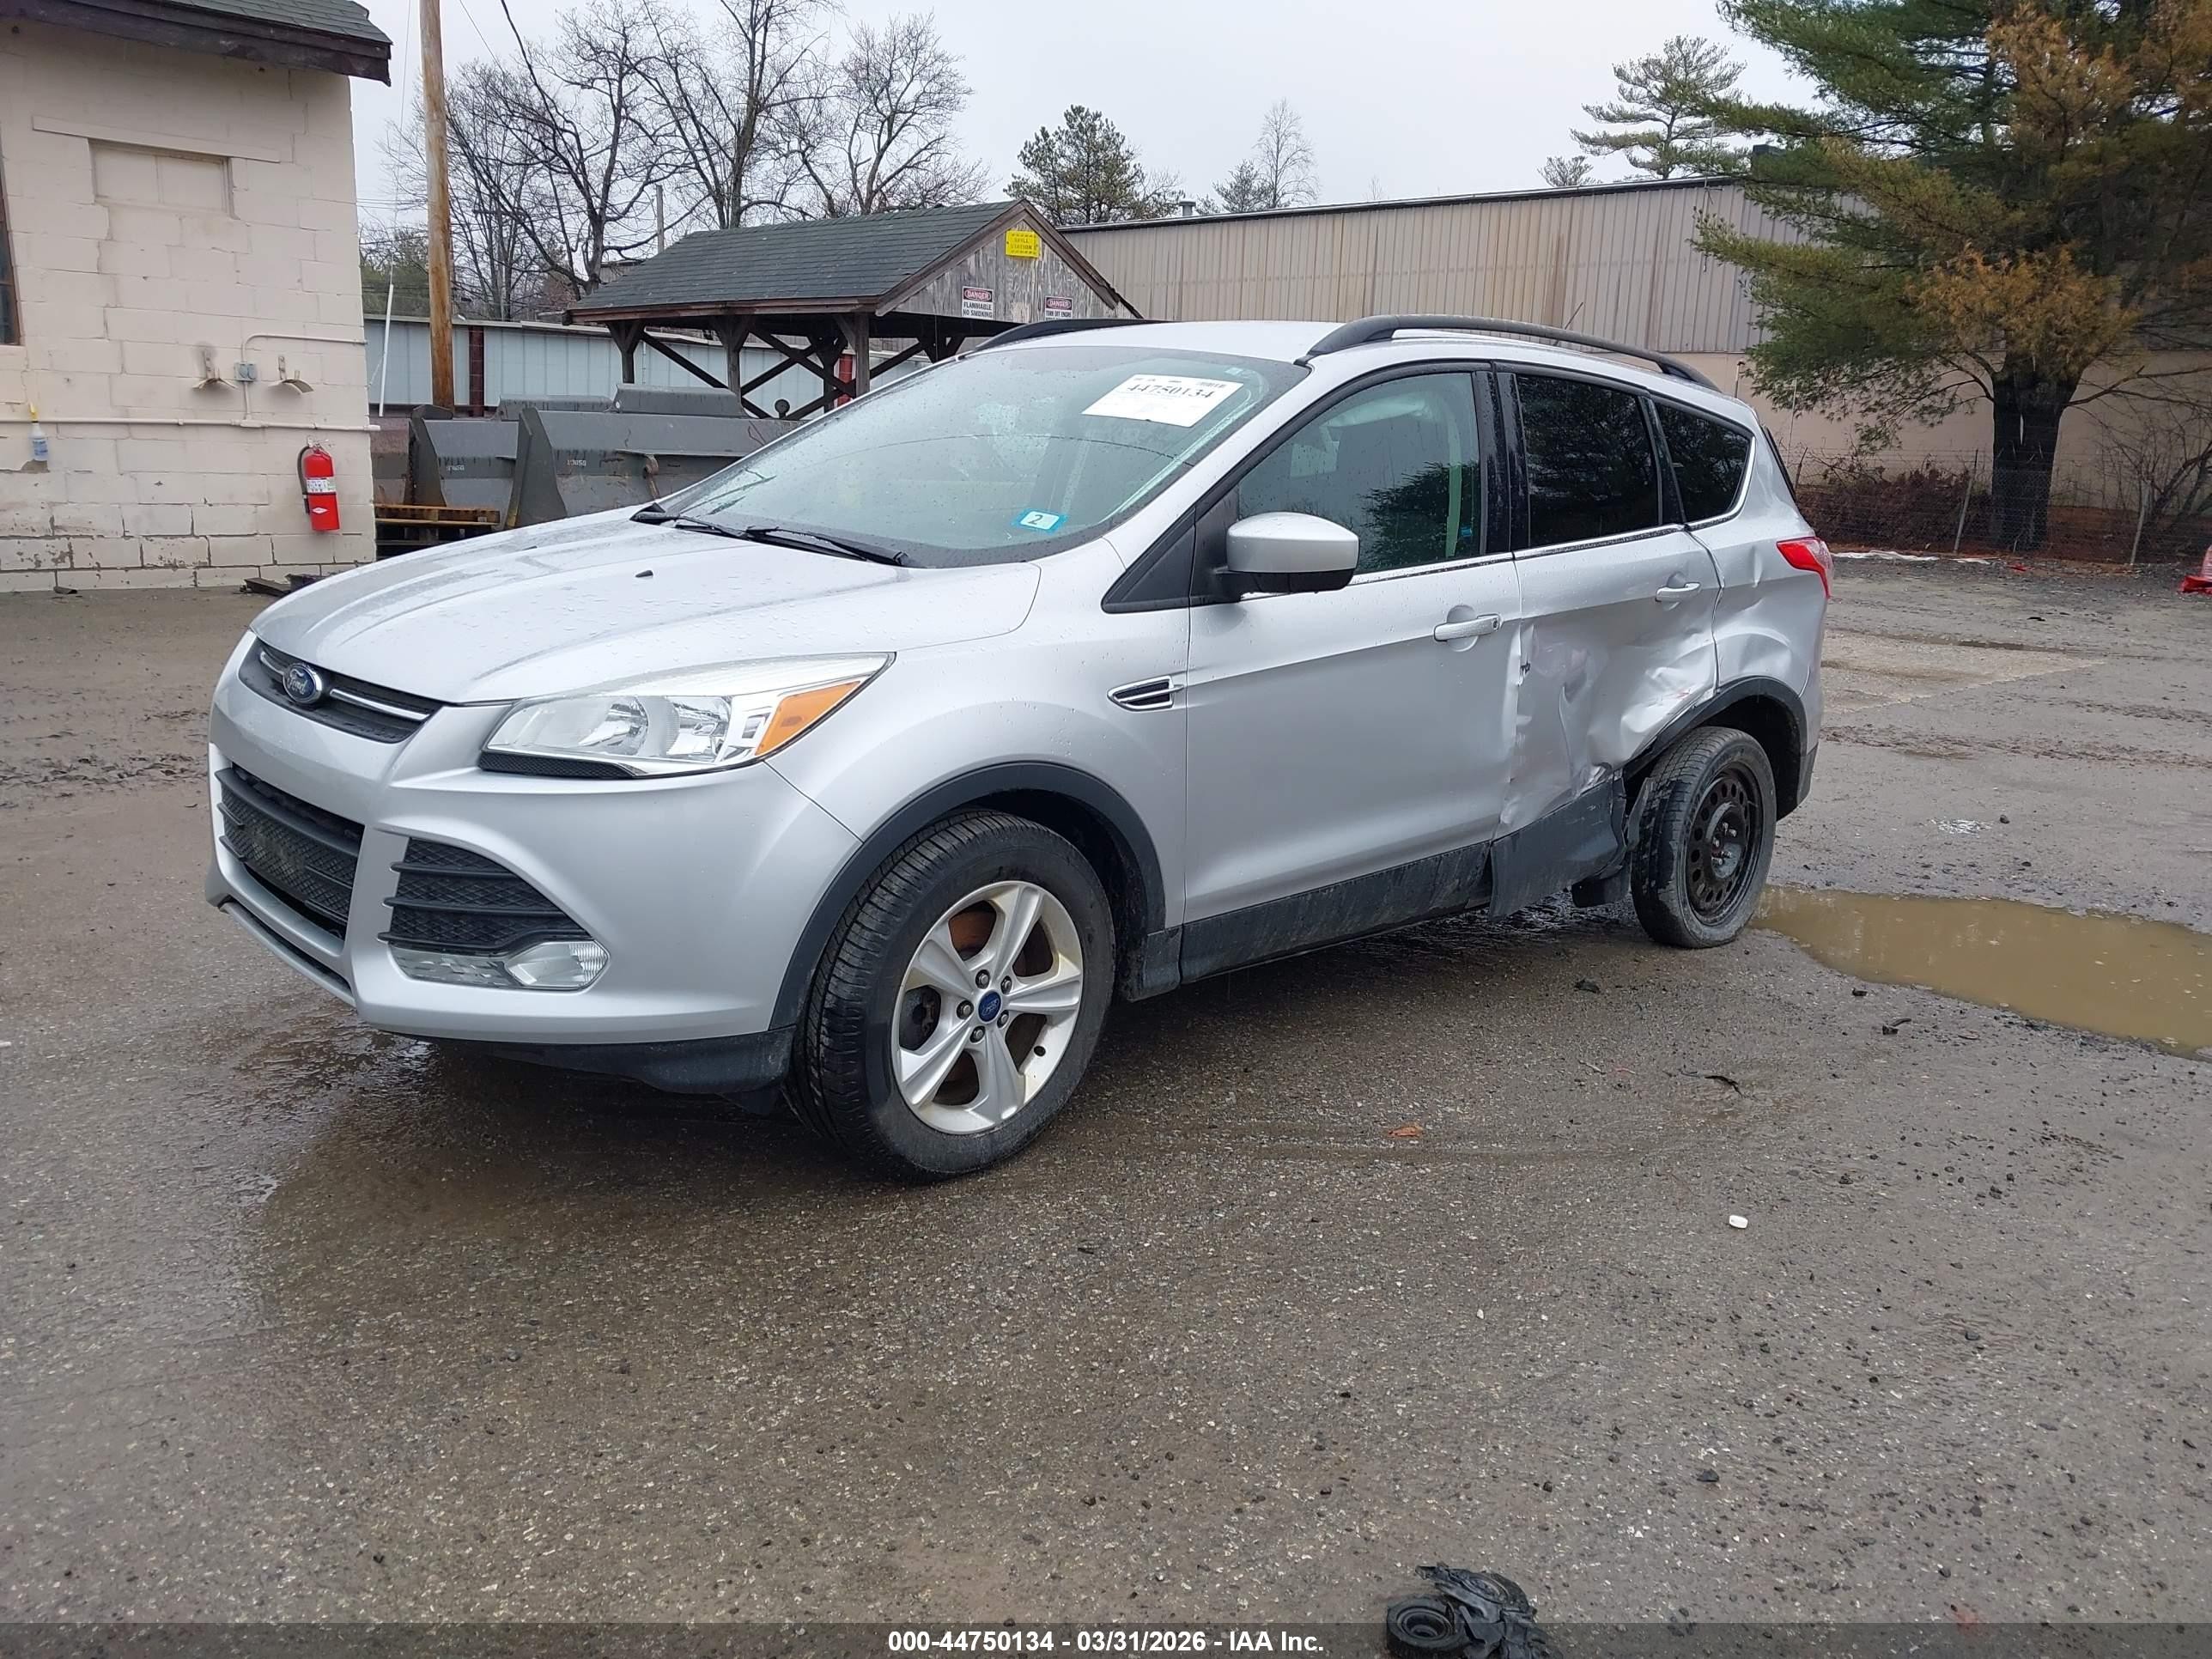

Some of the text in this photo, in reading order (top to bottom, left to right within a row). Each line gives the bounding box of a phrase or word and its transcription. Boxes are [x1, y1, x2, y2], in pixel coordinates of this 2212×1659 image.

[967, 290, 989, 300] DANGER
[963, 301, 992, 311] FLAMMABLE
[970, 309, 993, 318] SMOKING
[1127, 384, 1215, 398] 44750134
[1027, 514, 1043, 525] 2
[287, 668, 308, 695] Ford
